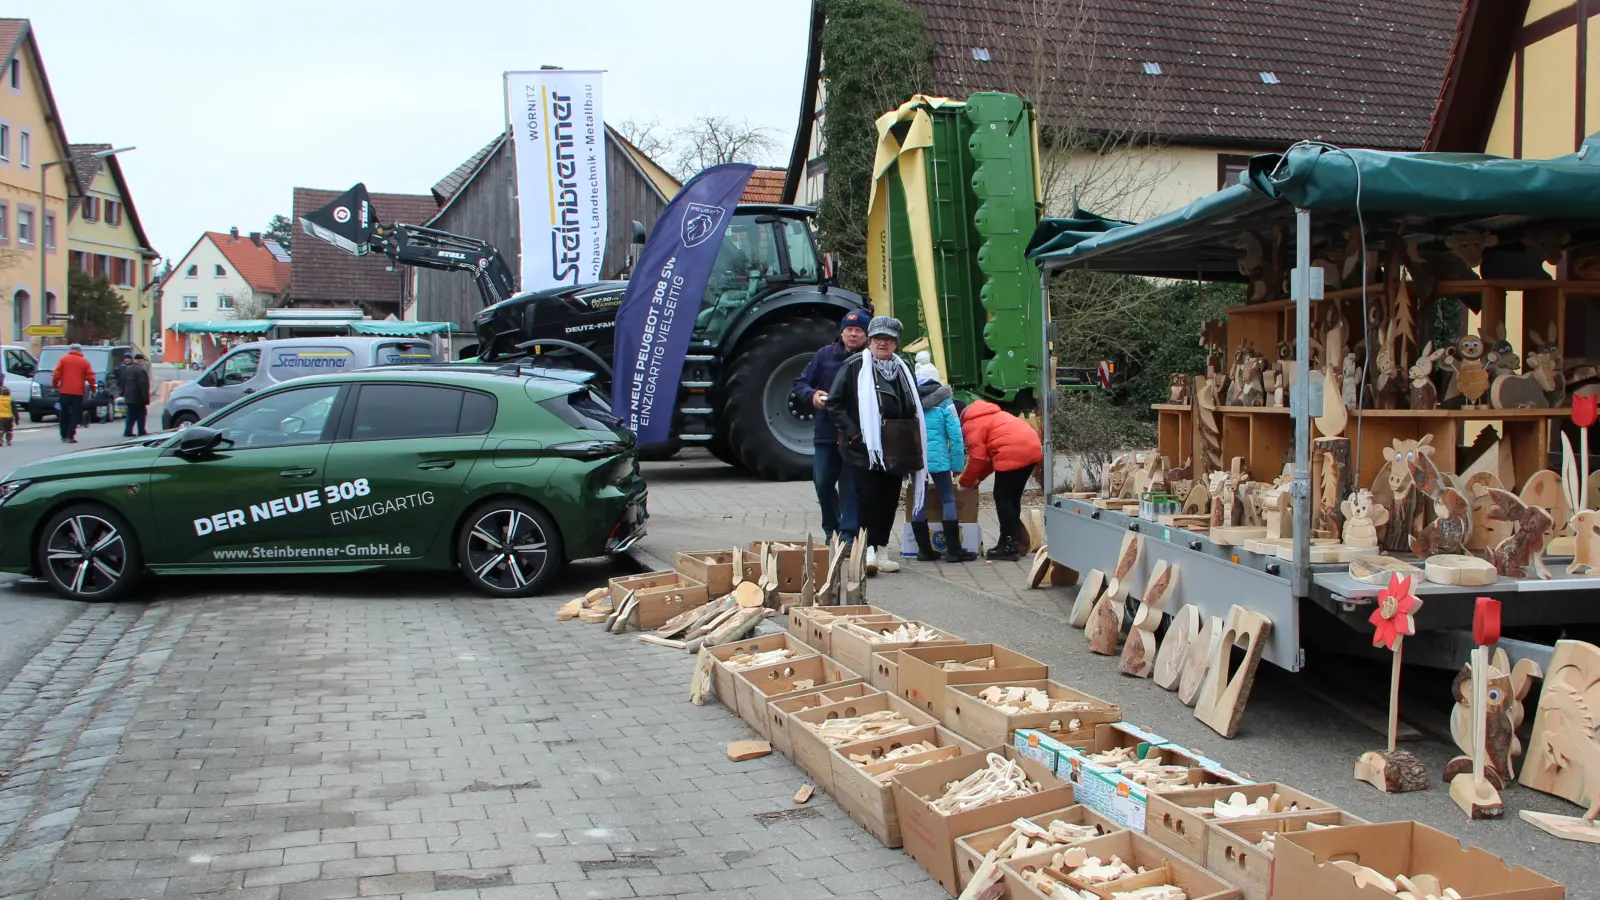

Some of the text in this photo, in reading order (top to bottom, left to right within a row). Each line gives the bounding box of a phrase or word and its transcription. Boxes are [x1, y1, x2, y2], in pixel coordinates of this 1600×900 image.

[526, 84, 538, 142] WÖRNITZ
[584, 84, 595, 145] Metallbau
[551, 91, 581, 285] Steinbrenner
[589, 155, 601, 229] Landtechnik
[437, 250, 466, 260] STOLL
[565, 321, 616, 334] DEUTZ-FAH
[630, 256, 677, 437] ER NEUE PEUGEOT 308 SW
[640, 275, 684, 427] EINZIGARTIG VIELSEITIG
[272, 353, 347, 368] Steinbrenner
[193, 478, 371, 537] DER NEUE 308
[330, 490, 436, 526] EINZIGARTIG
[213, 542, 412, 560] www.Steinbrenner-GmbH.de
